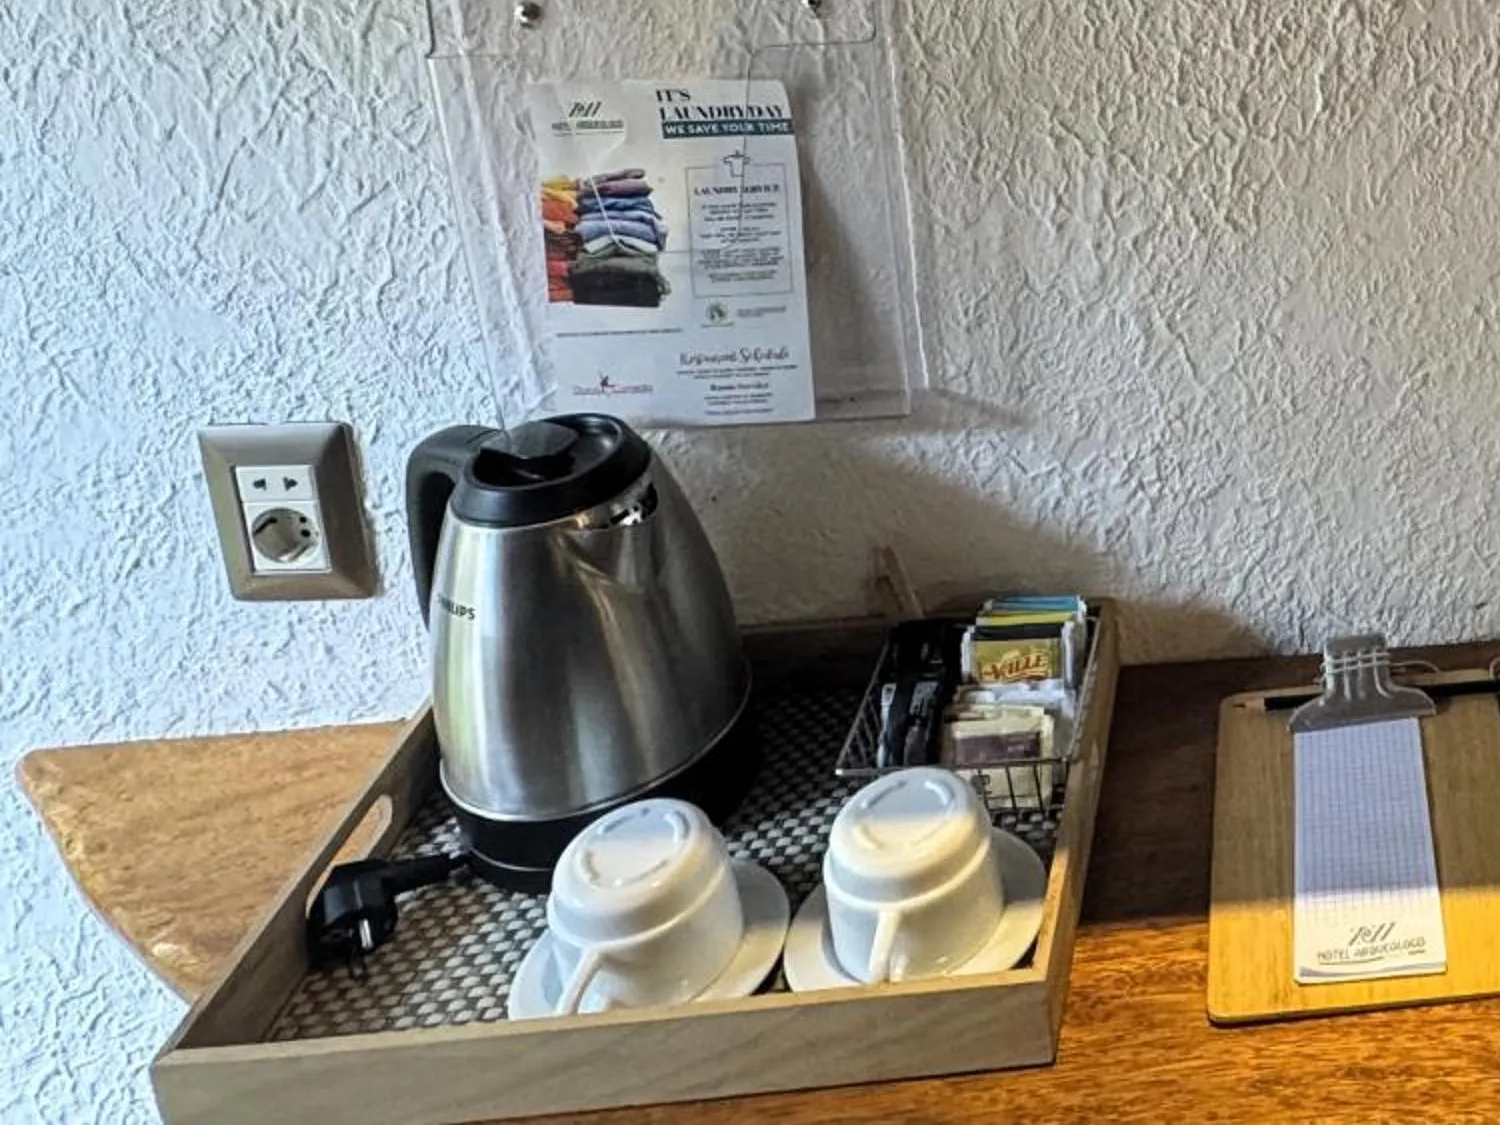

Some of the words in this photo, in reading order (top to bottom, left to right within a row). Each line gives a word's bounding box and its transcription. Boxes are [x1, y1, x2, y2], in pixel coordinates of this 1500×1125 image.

[665, 125, 685, 135] WE
[687, 124, 721, 134] SAVE
[723, 124, 755, 134] YOUR
[759, 123, 790, 132] TIME
[1316, 948, 1350, 961] HOTEL
